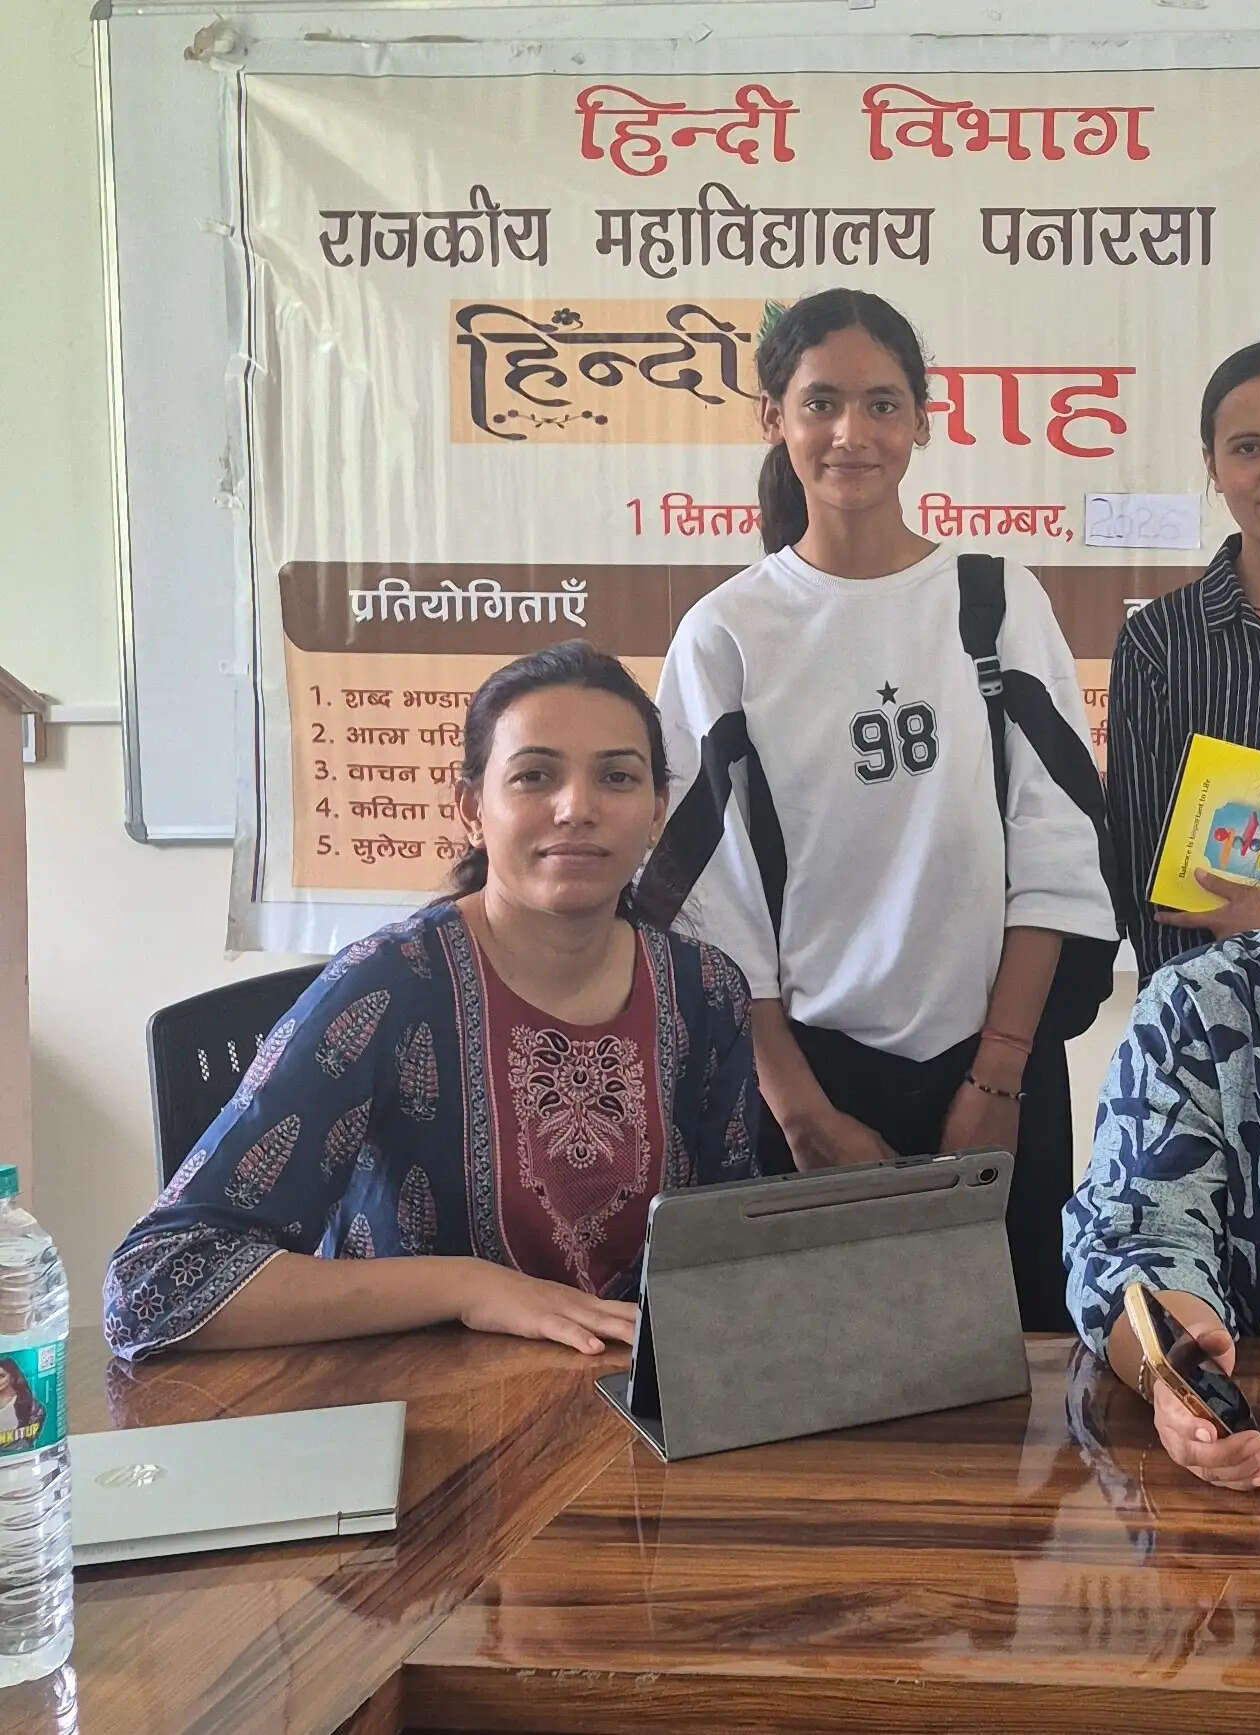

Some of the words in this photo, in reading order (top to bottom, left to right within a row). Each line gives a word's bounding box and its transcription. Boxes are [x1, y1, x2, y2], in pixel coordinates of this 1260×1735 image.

[575, 84, 800, 176] हिन्दी
[862, 84, 1154, 161] विभाग
[319, 184, 550, 268] राजकीय
[595, 182, 935, 279] महाविद्यालय
[980, 206, 1216, 267] पनारसा
[627, 498, 642, 536] 1
[918, 492, 1074, 542] सितम्बर,
[348, 577, 589, 628] प्रतियोगिताएँ
[310, 685, 332, 706] 1.
[341, 688, 393, 709] शब्द
[311, 722, 335, 744] 2.
[346, 727, 410, 746] आत्म
[848, 700, 940, 785] 98
[314, 759, 337, 781] 3.
[347, 763, 420, 783] वाचन
[315, 797, 339, 819] 4.
[349, 795, 429, 820] कविता
[316, 835, 340, 856] 5.
[351, 833, 426, 865] सुलेख
